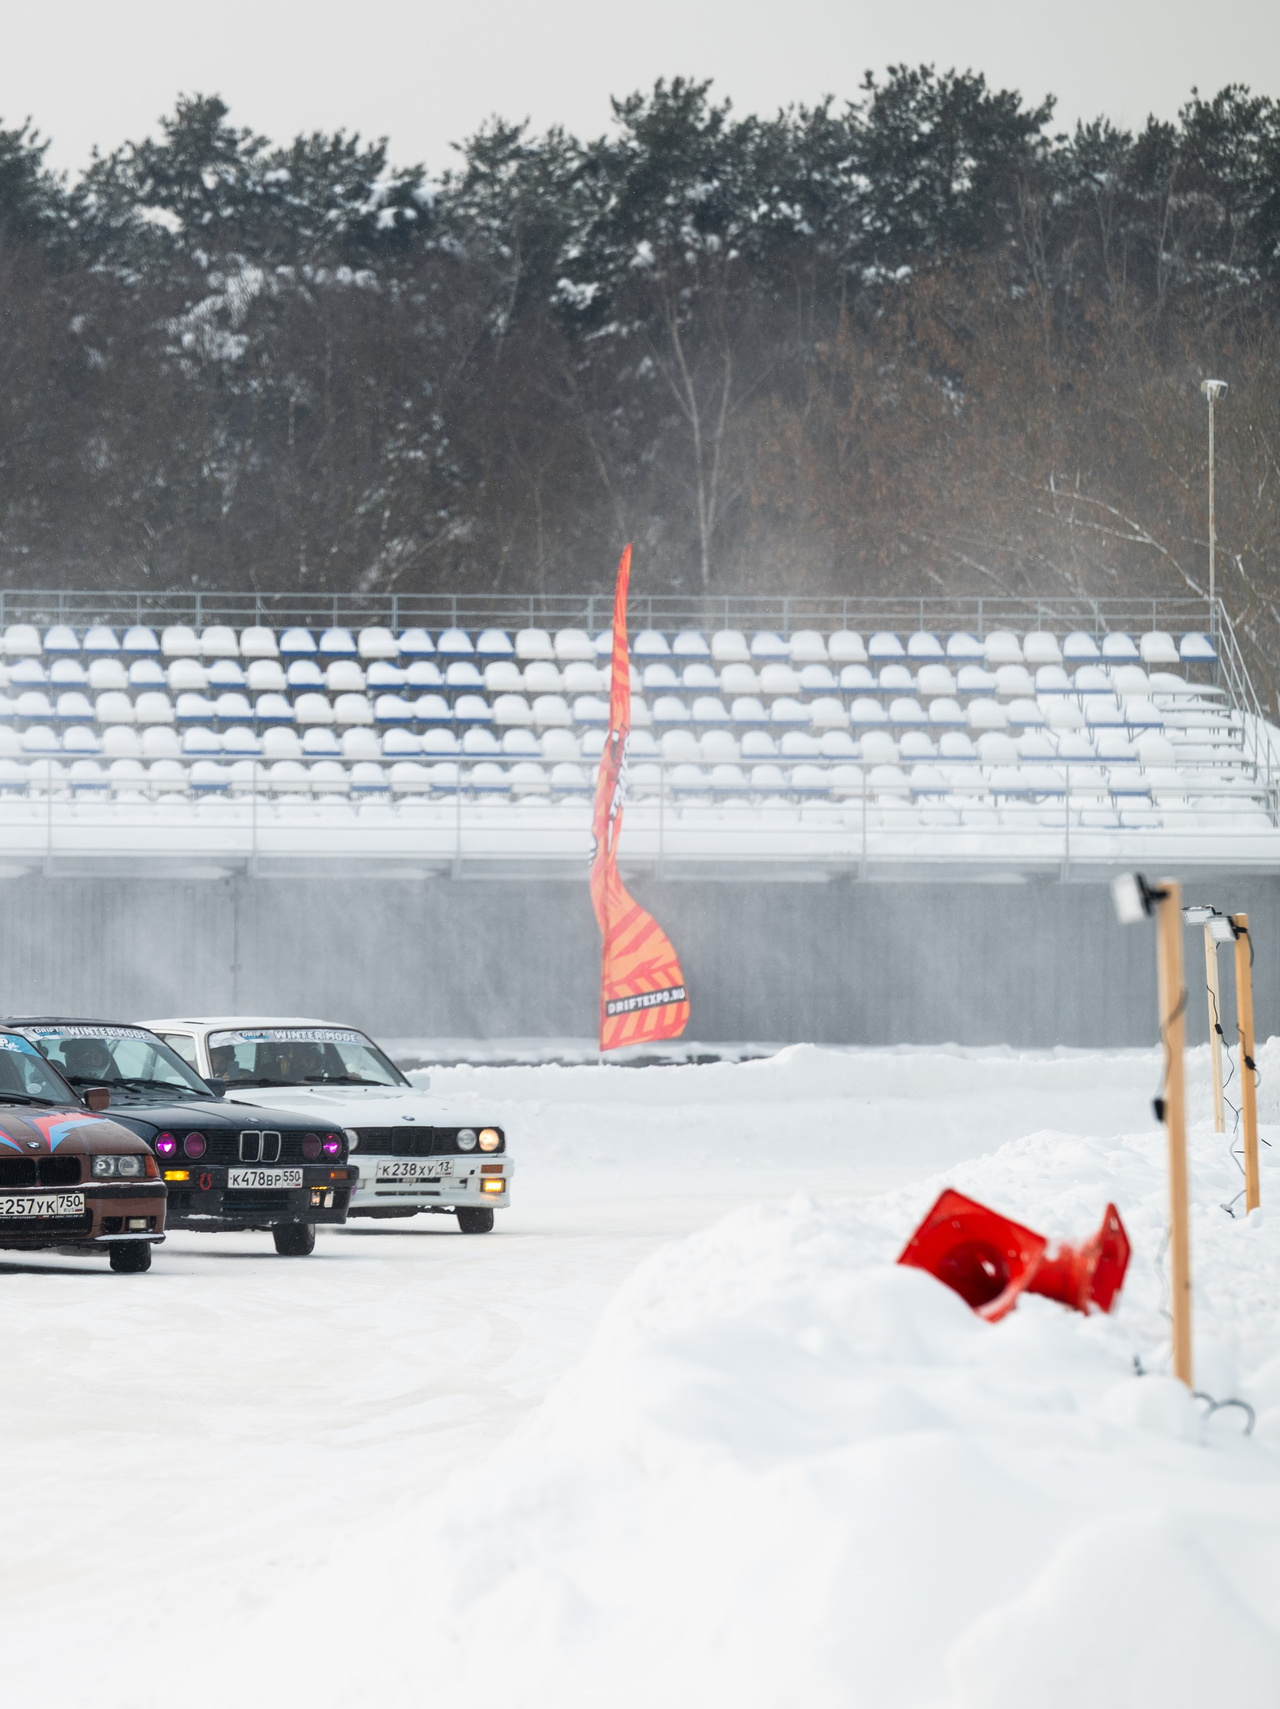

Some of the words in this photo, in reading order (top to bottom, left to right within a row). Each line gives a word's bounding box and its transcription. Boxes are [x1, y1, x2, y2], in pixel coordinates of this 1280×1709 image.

[607, 987, 686, 1015] DRIFTEXPO.RU
[66, 1026, 114, 1037] WINTER
[116, 1028, 149, 1040] MODE
[273, 1030, 321, 1040] WINTER
[324, 1031, 358, 1042] MODE
[438, 1161, 449, 1172] 13
[283, 1169, 299, 1182] 550
[58, 1195, 81, 1209] 750
